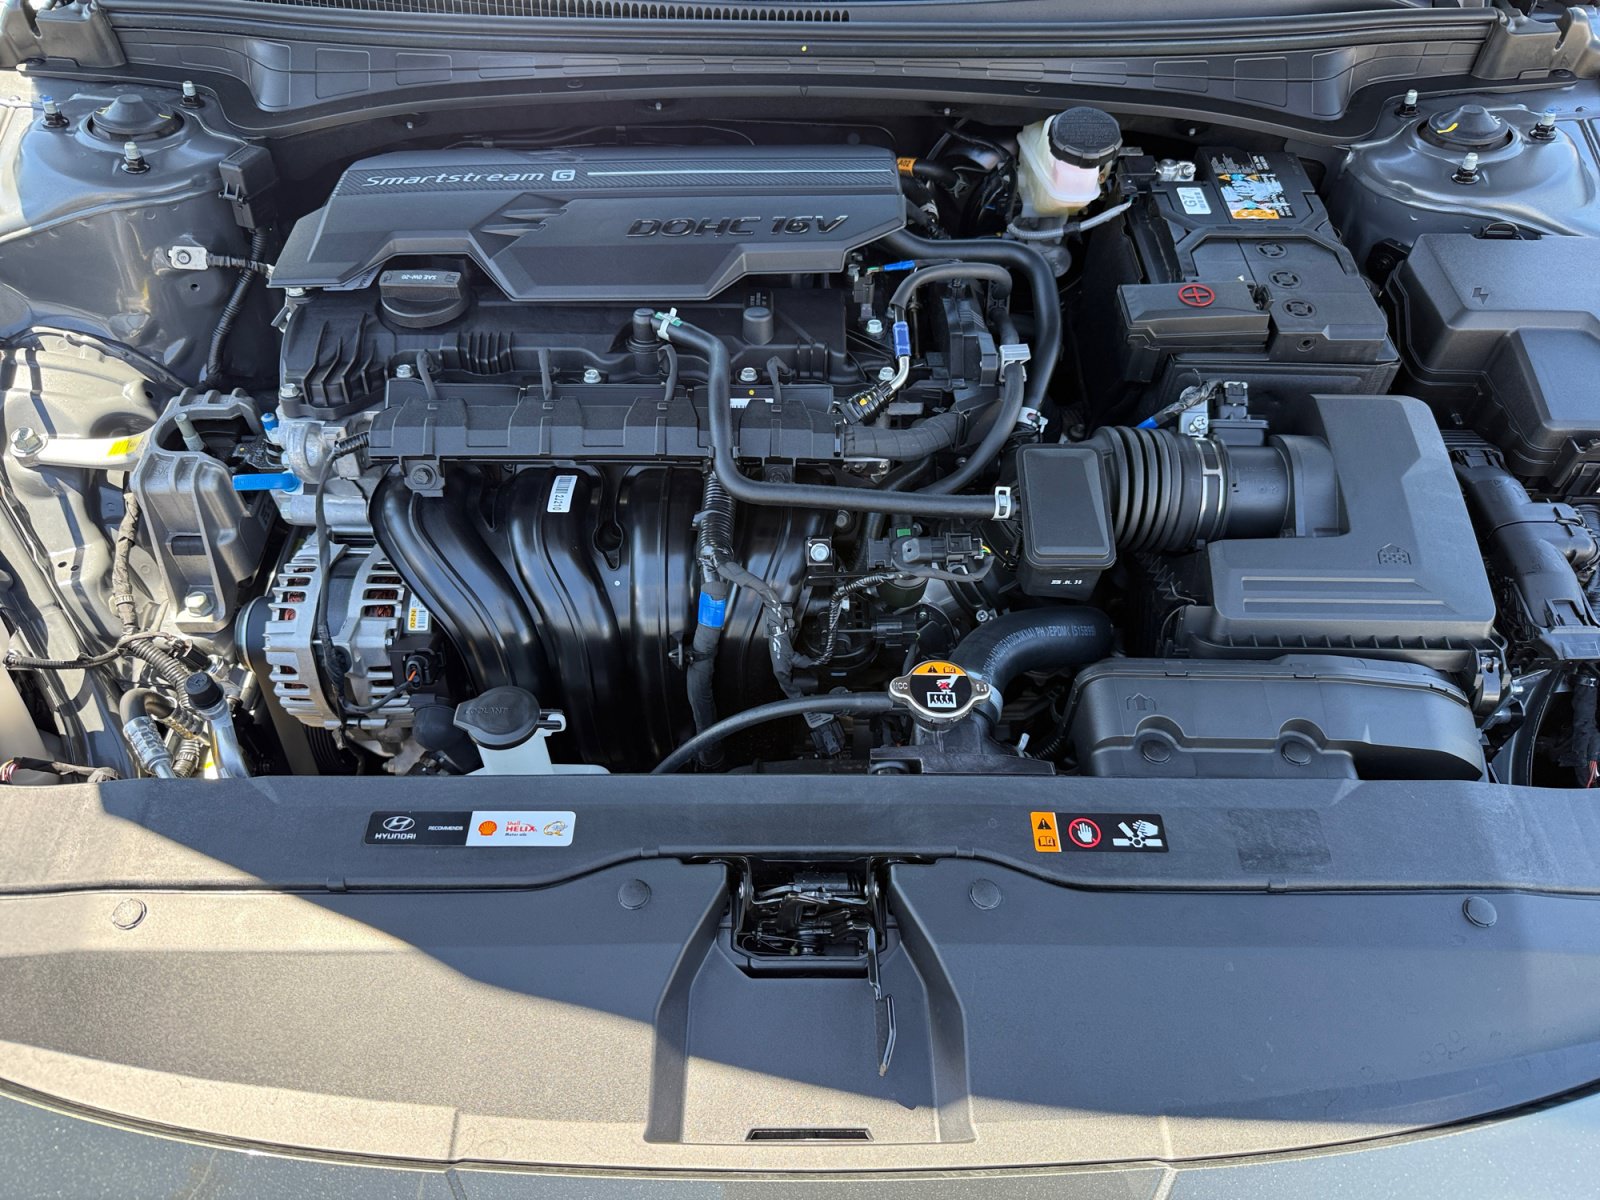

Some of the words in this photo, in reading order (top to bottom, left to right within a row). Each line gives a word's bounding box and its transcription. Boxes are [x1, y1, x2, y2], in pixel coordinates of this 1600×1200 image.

[361, 172, 545, 187] Smartstream
[625, 216, 761, 236] DOHC
[770, 214, 849, 235] 16V
